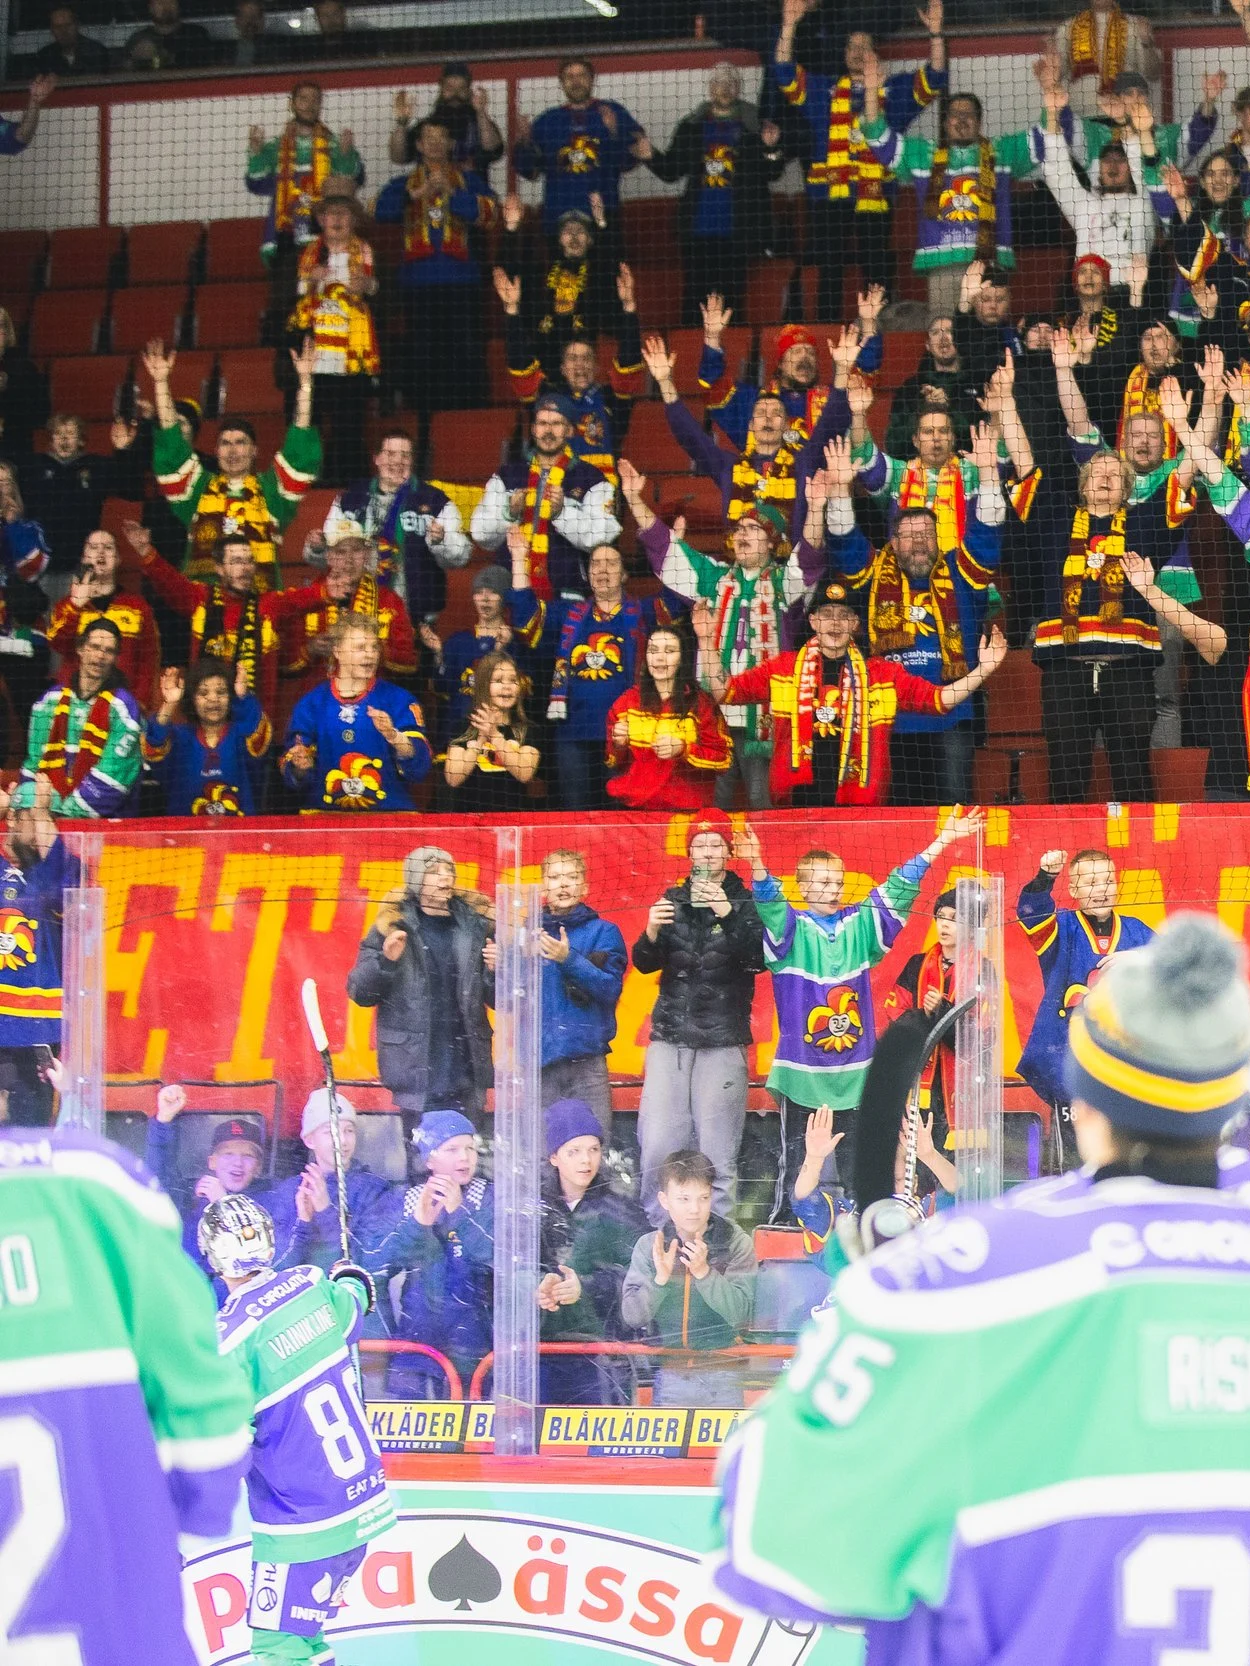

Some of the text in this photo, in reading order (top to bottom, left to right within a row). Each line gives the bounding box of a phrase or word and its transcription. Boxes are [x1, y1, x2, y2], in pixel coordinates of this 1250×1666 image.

[1061, 1106, 1078, 1122] 58
[549, 1411, 680, 1443] BLÅKLÄDER
[381, 1441, 442, 1450] WORKWEAR
[603, 1446, 665, 1455] WORKWEAR
